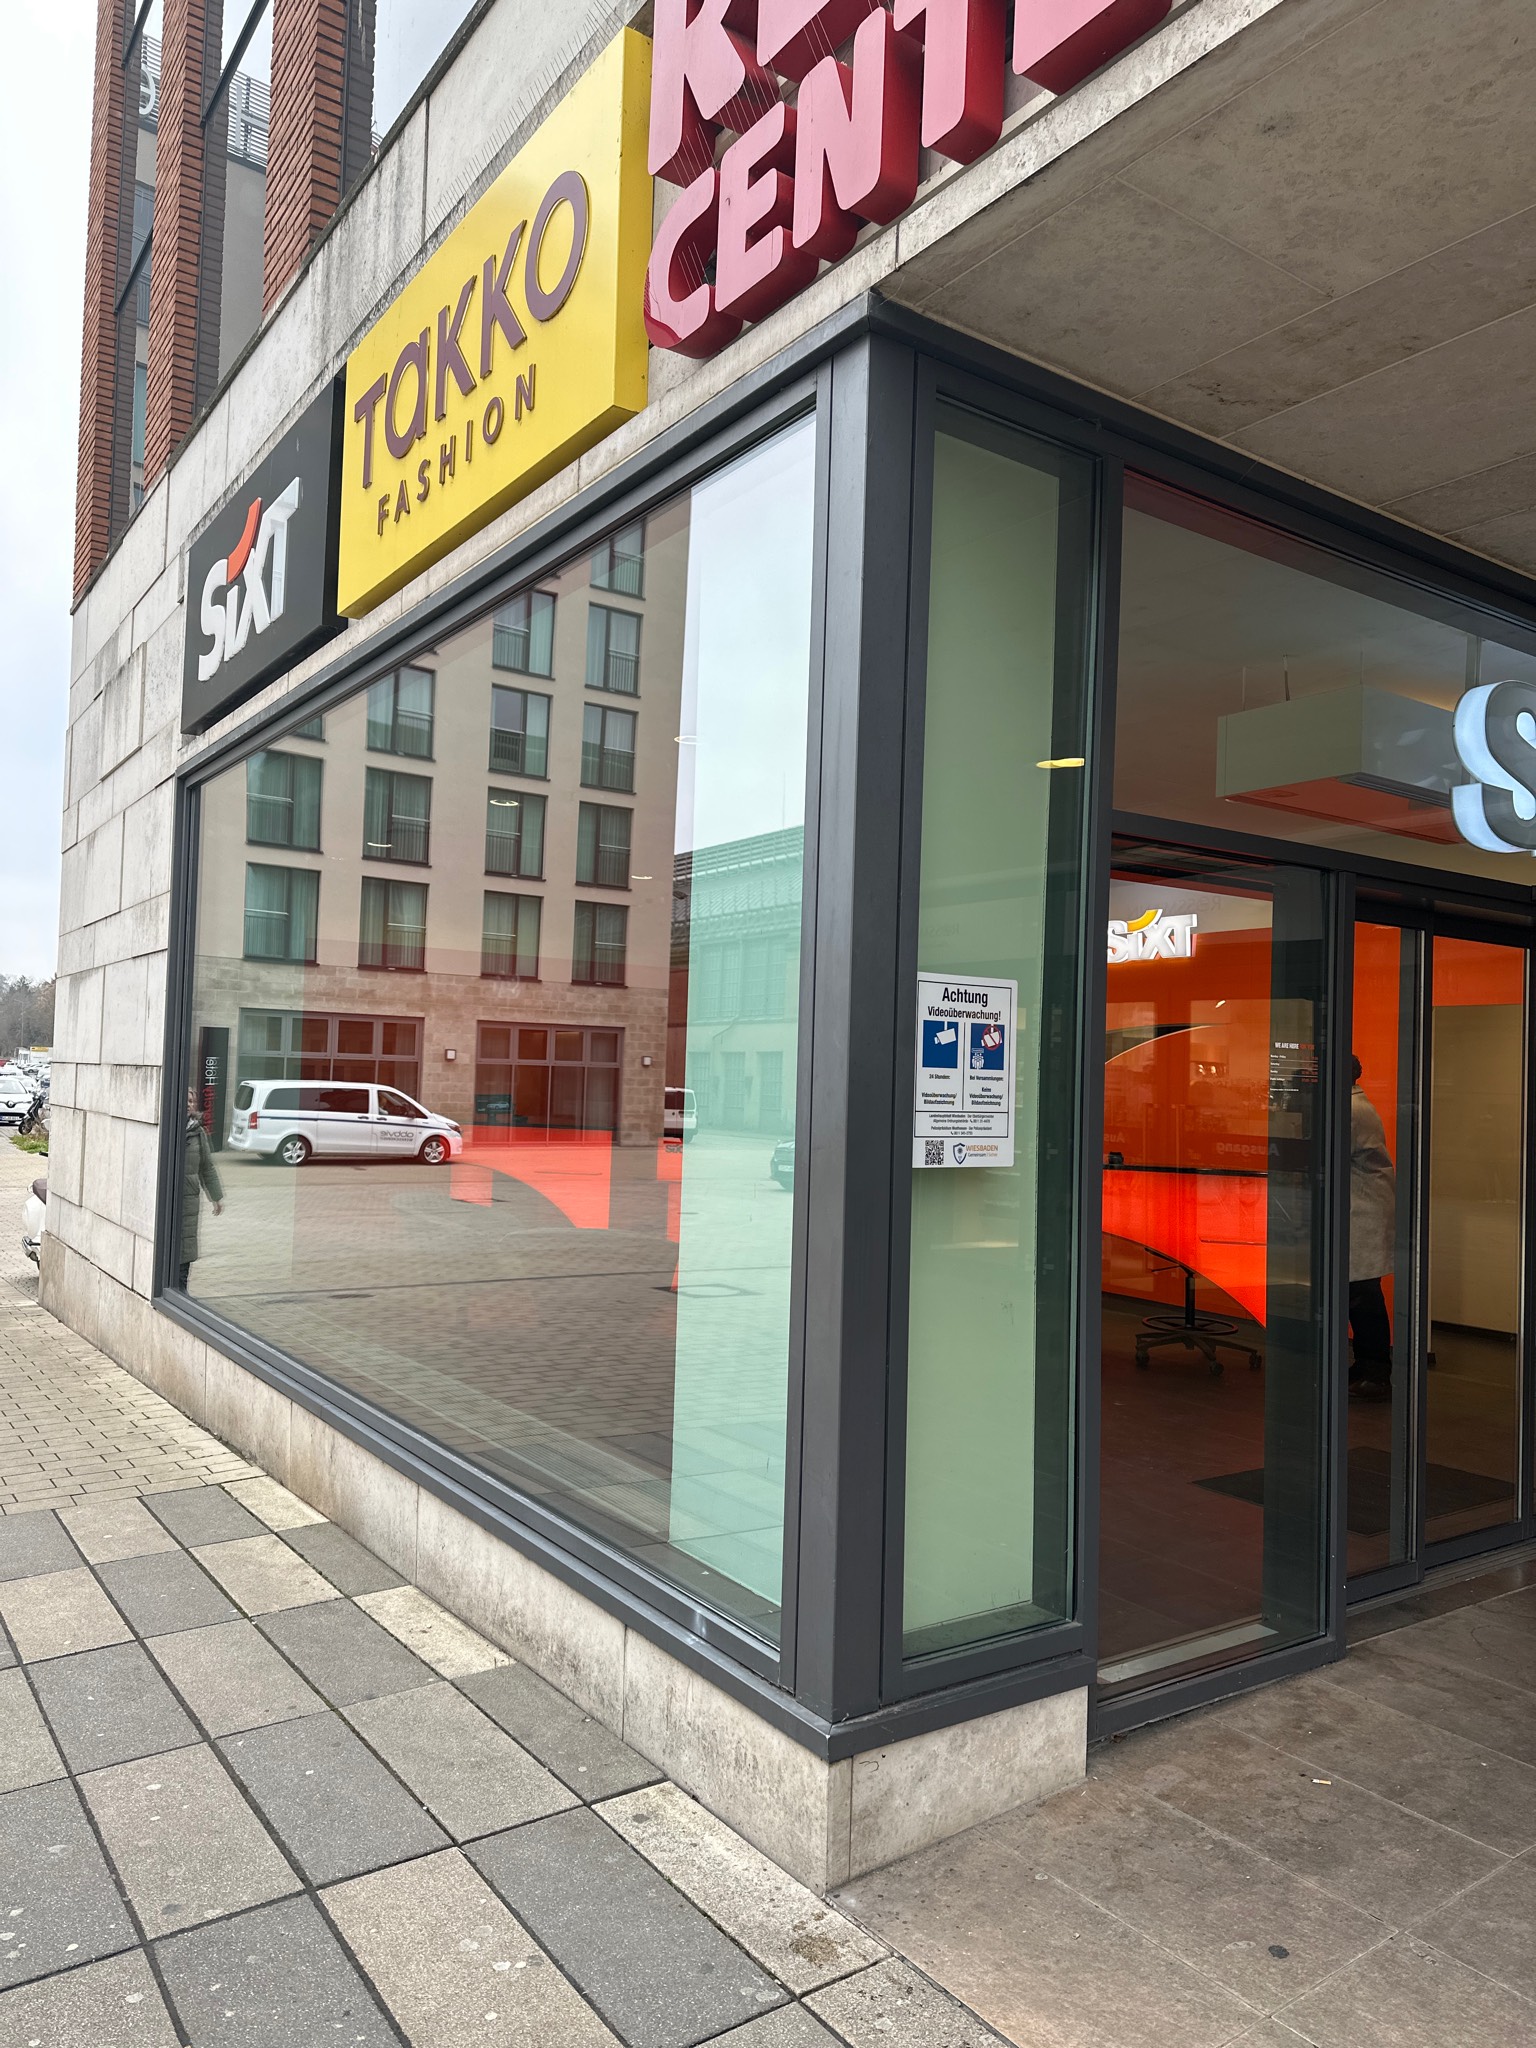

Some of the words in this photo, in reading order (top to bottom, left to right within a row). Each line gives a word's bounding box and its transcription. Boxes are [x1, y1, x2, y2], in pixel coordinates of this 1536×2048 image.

[377, 363, 537, 536] FASHION
[941, 986, 988, 1008] Achtung
[927, 1005, 1001, 1023] Videoüberwachung!
[965, 1144, 999, 1152] WIESBADEN
